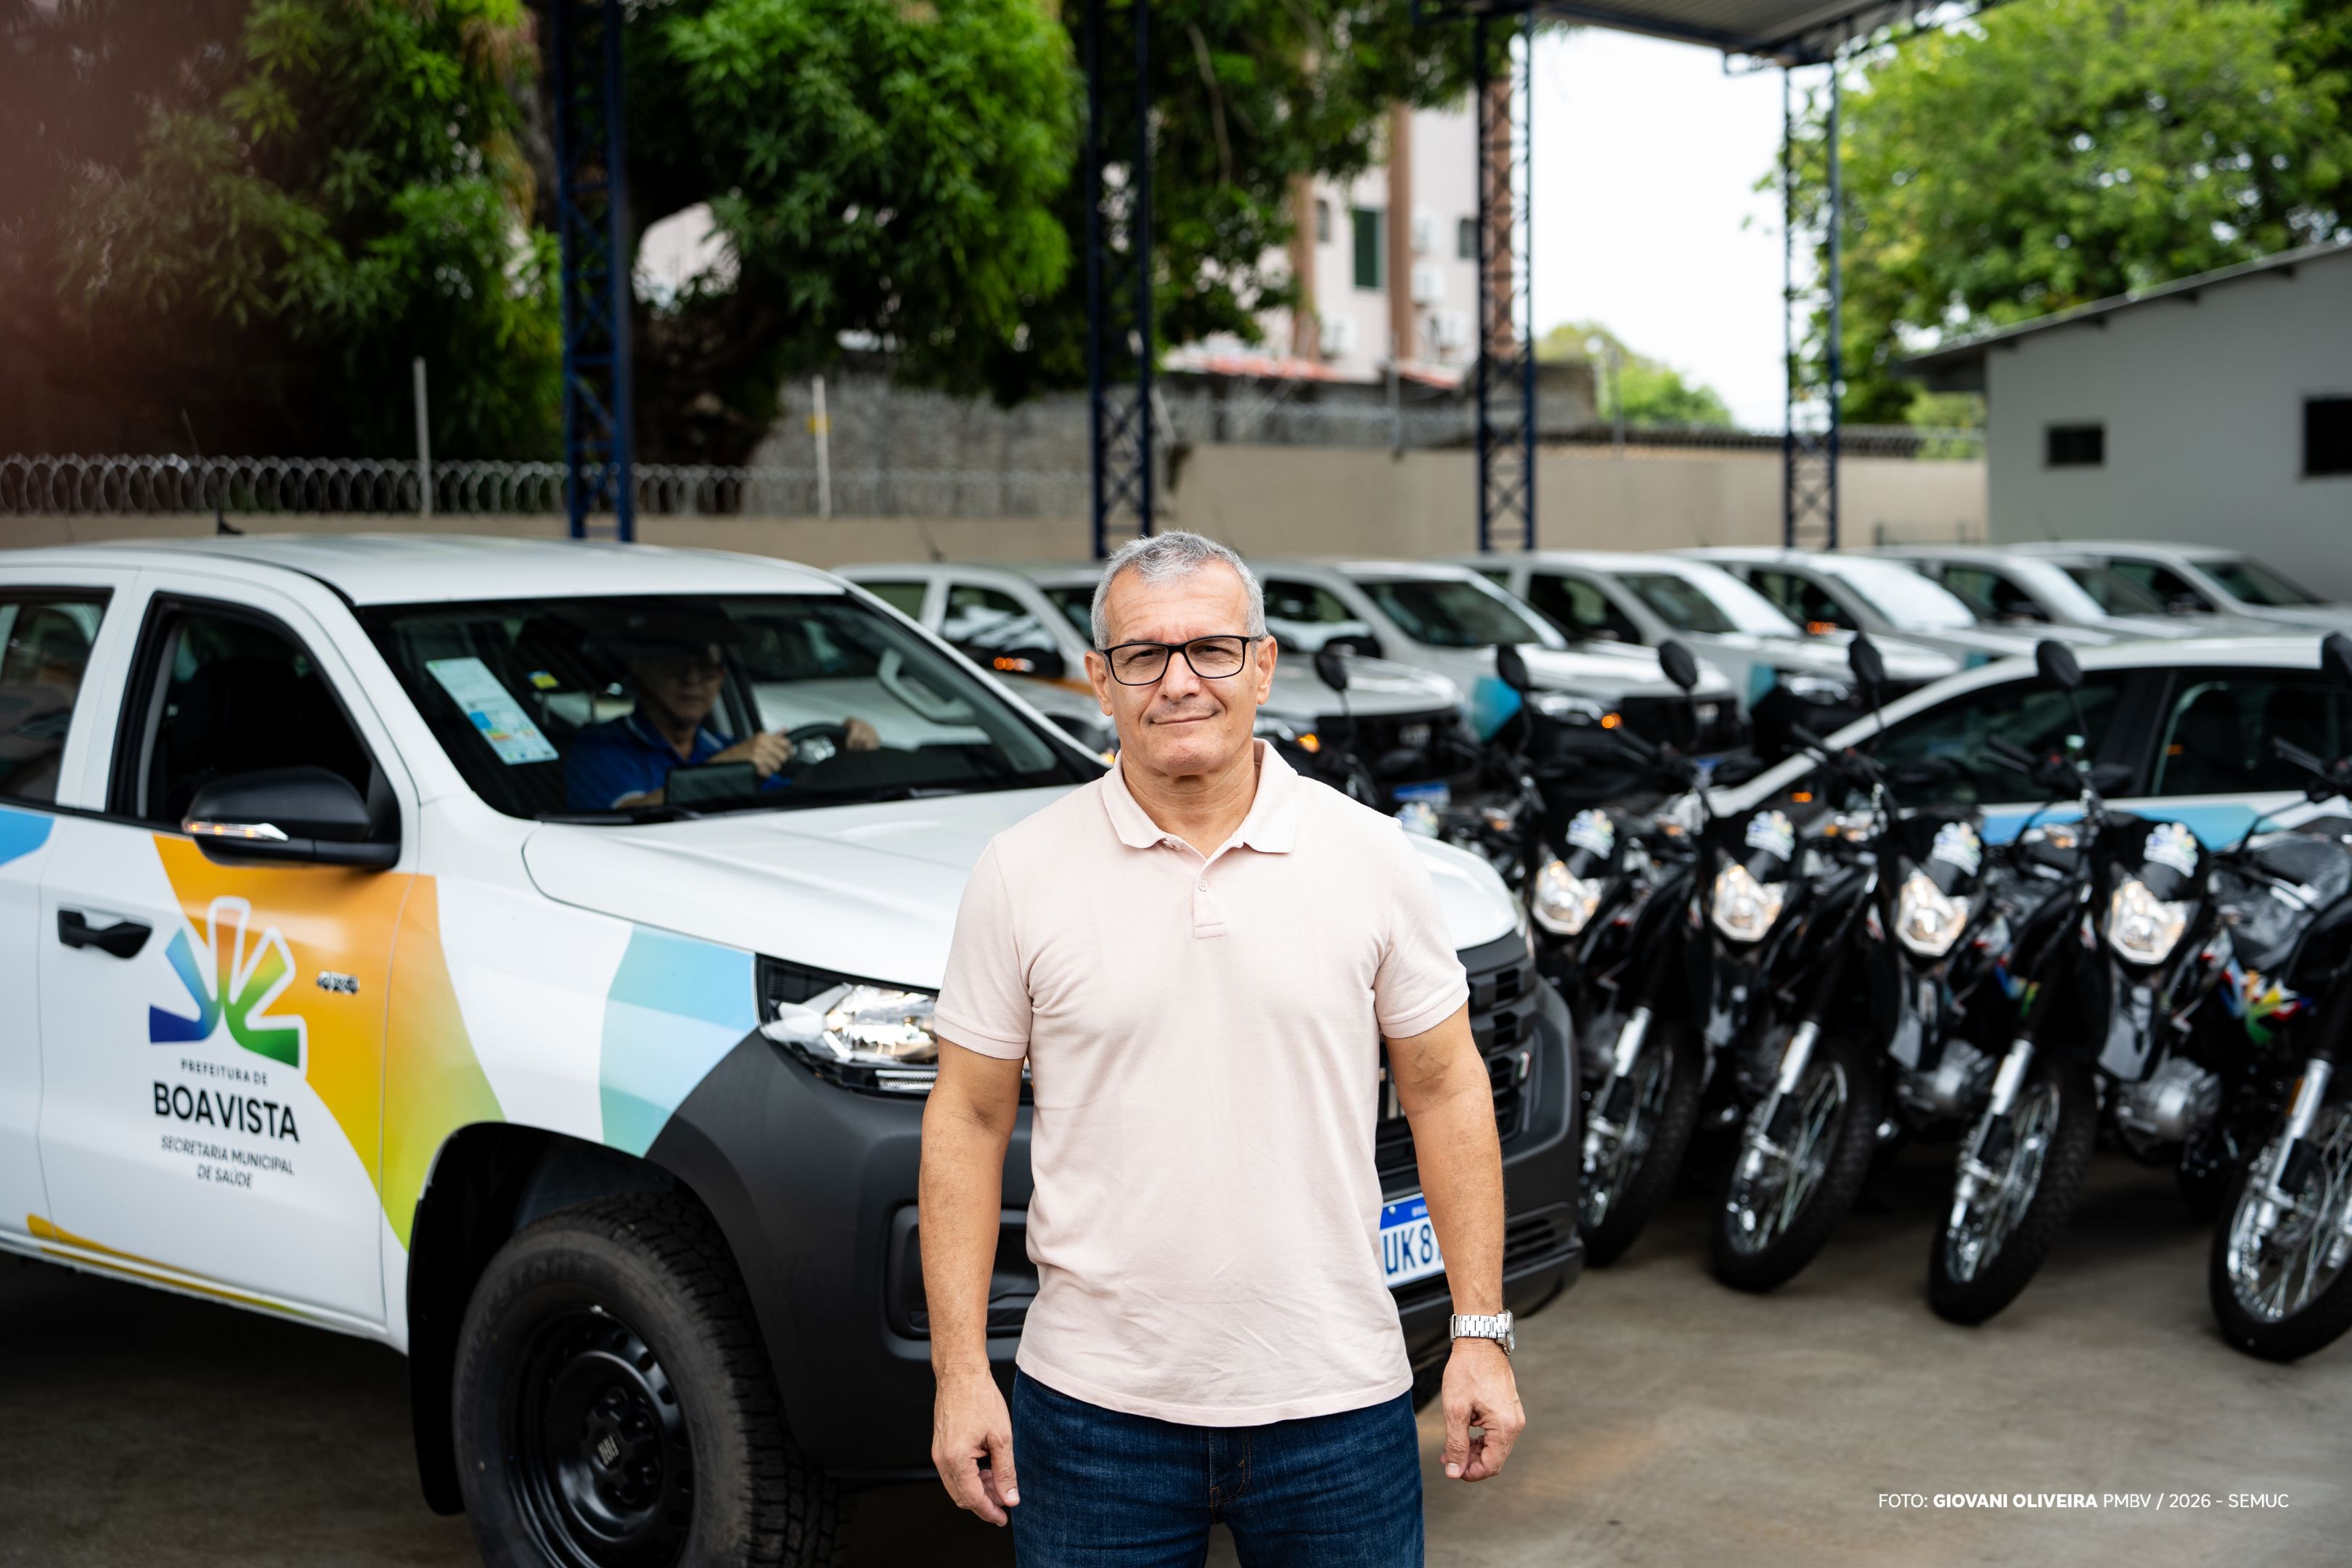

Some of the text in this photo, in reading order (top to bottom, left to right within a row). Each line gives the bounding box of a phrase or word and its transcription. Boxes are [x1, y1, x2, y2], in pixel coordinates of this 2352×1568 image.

[181, 1058, 267, 1086] PREFEITURA DE
[161, 1135, 294, 1175] SECRETARIA MUNICIPAL
[197, 1164, 252, 1188] DE SAÚDE
[1384, 1224, 1442, 1275] UK8
